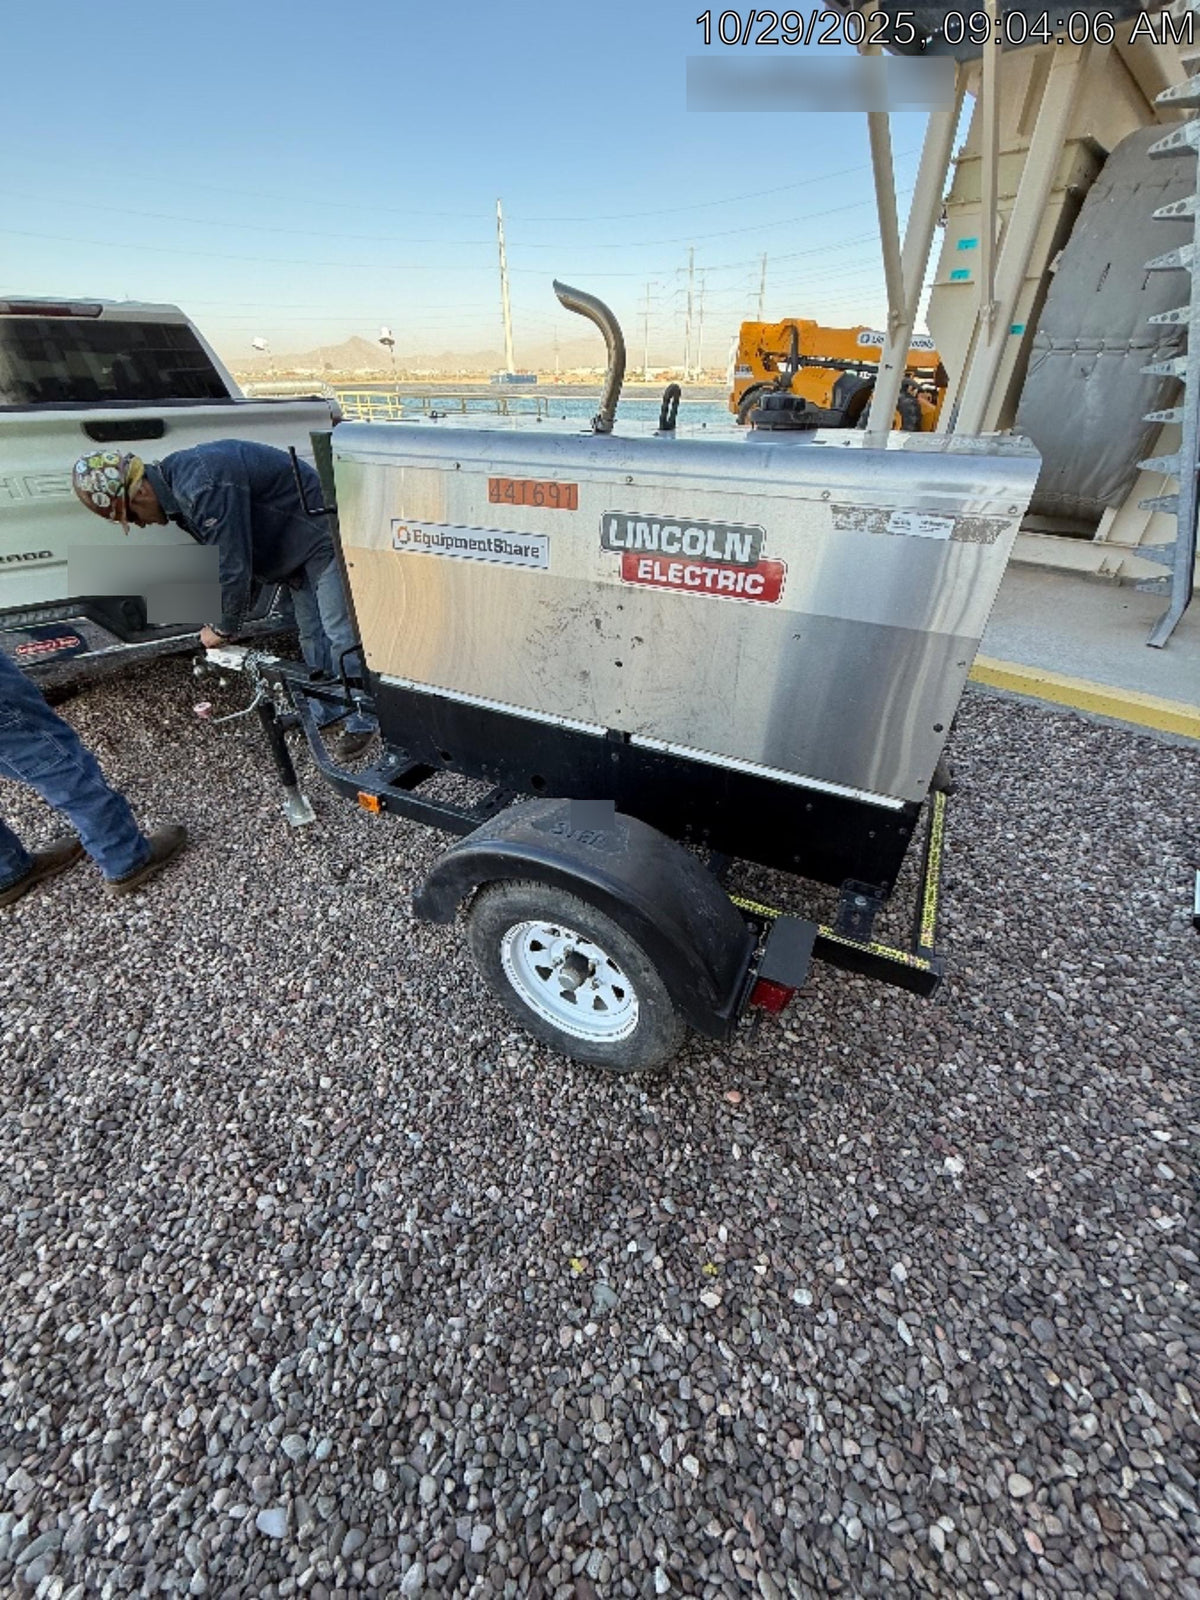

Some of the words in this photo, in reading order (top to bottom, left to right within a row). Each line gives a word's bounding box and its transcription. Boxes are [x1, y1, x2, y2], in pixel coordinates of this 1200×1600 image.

[489, 478, 573, 509] 441691
[412, 528, 541, 559] EquipmentShare
[608, 518, 753, 562] LINCOLN
[637, 559, 765, 595] ELECTRIC
